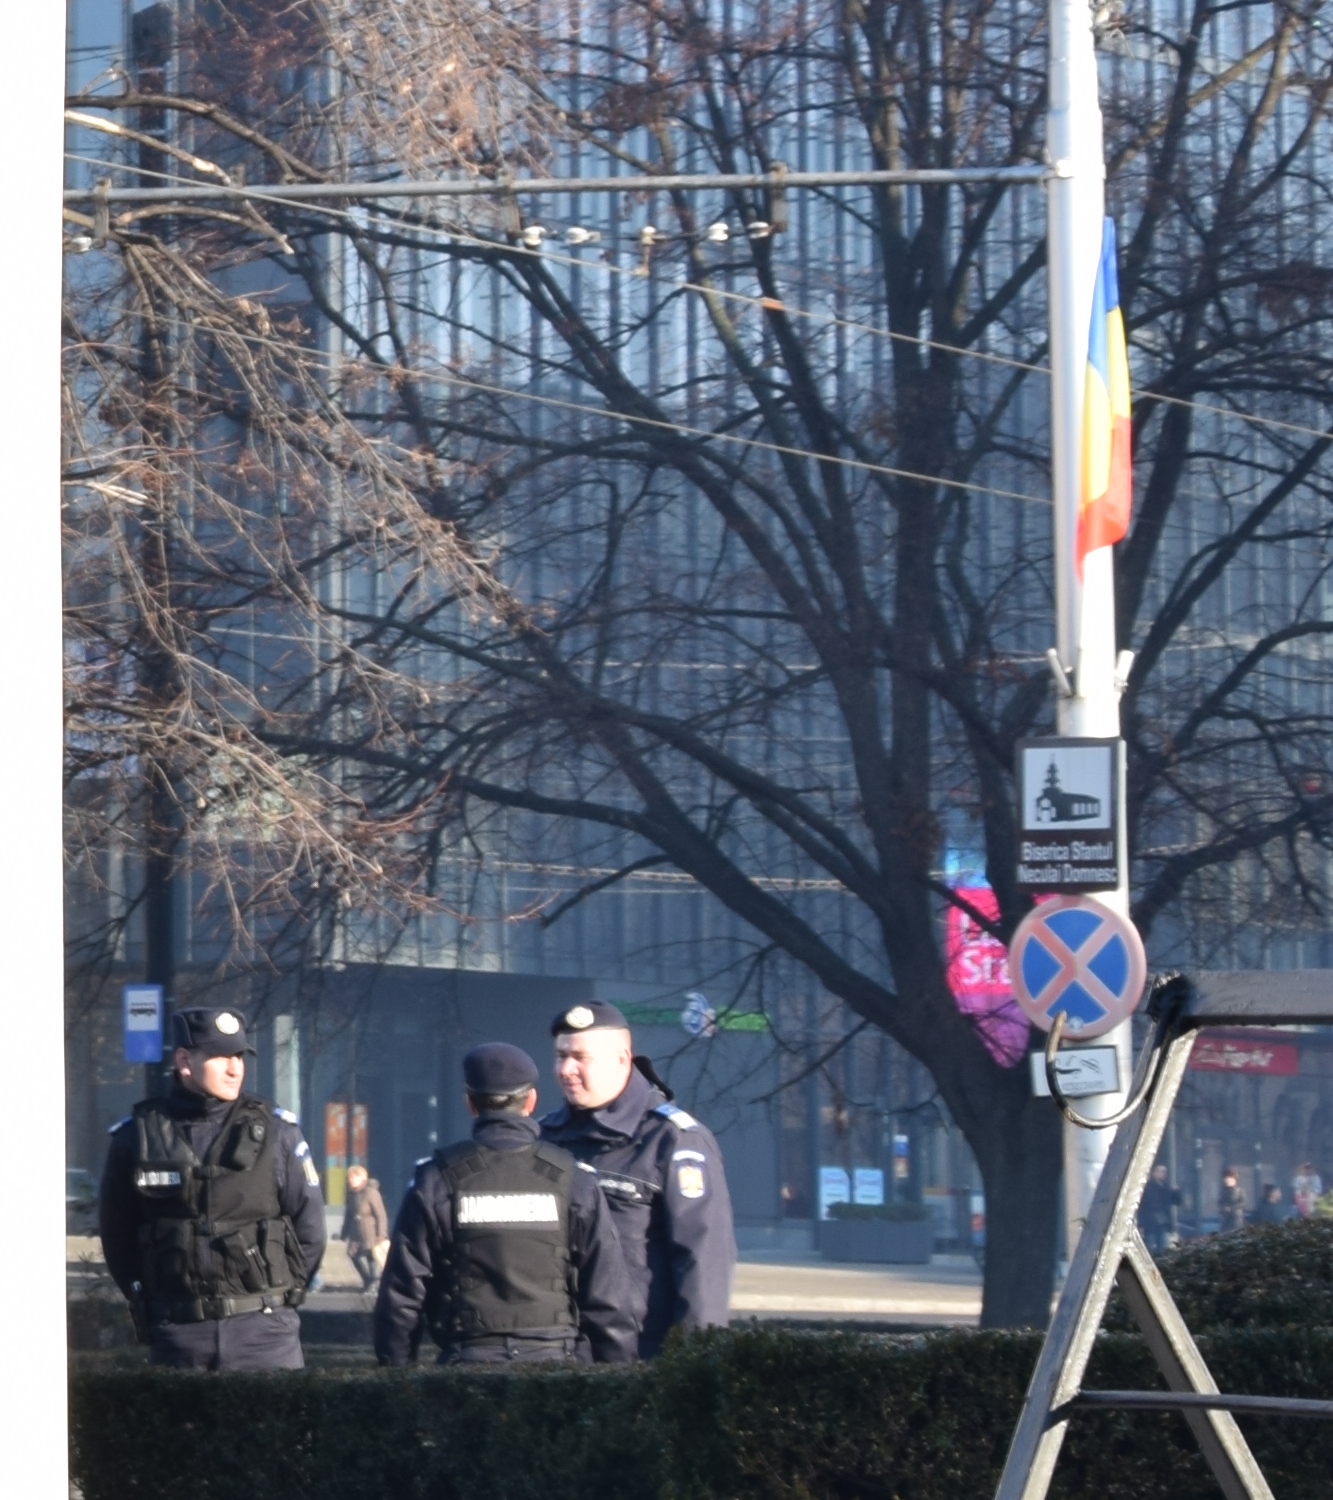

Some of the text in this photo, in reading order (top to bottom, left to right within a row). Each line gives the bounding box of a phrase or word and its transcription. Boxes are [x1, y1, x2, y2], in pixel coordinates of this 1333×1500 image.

[1021, 841, 1070, 861] Biserica
[1017, 862, 1118, 883] Neculai Domnesc
